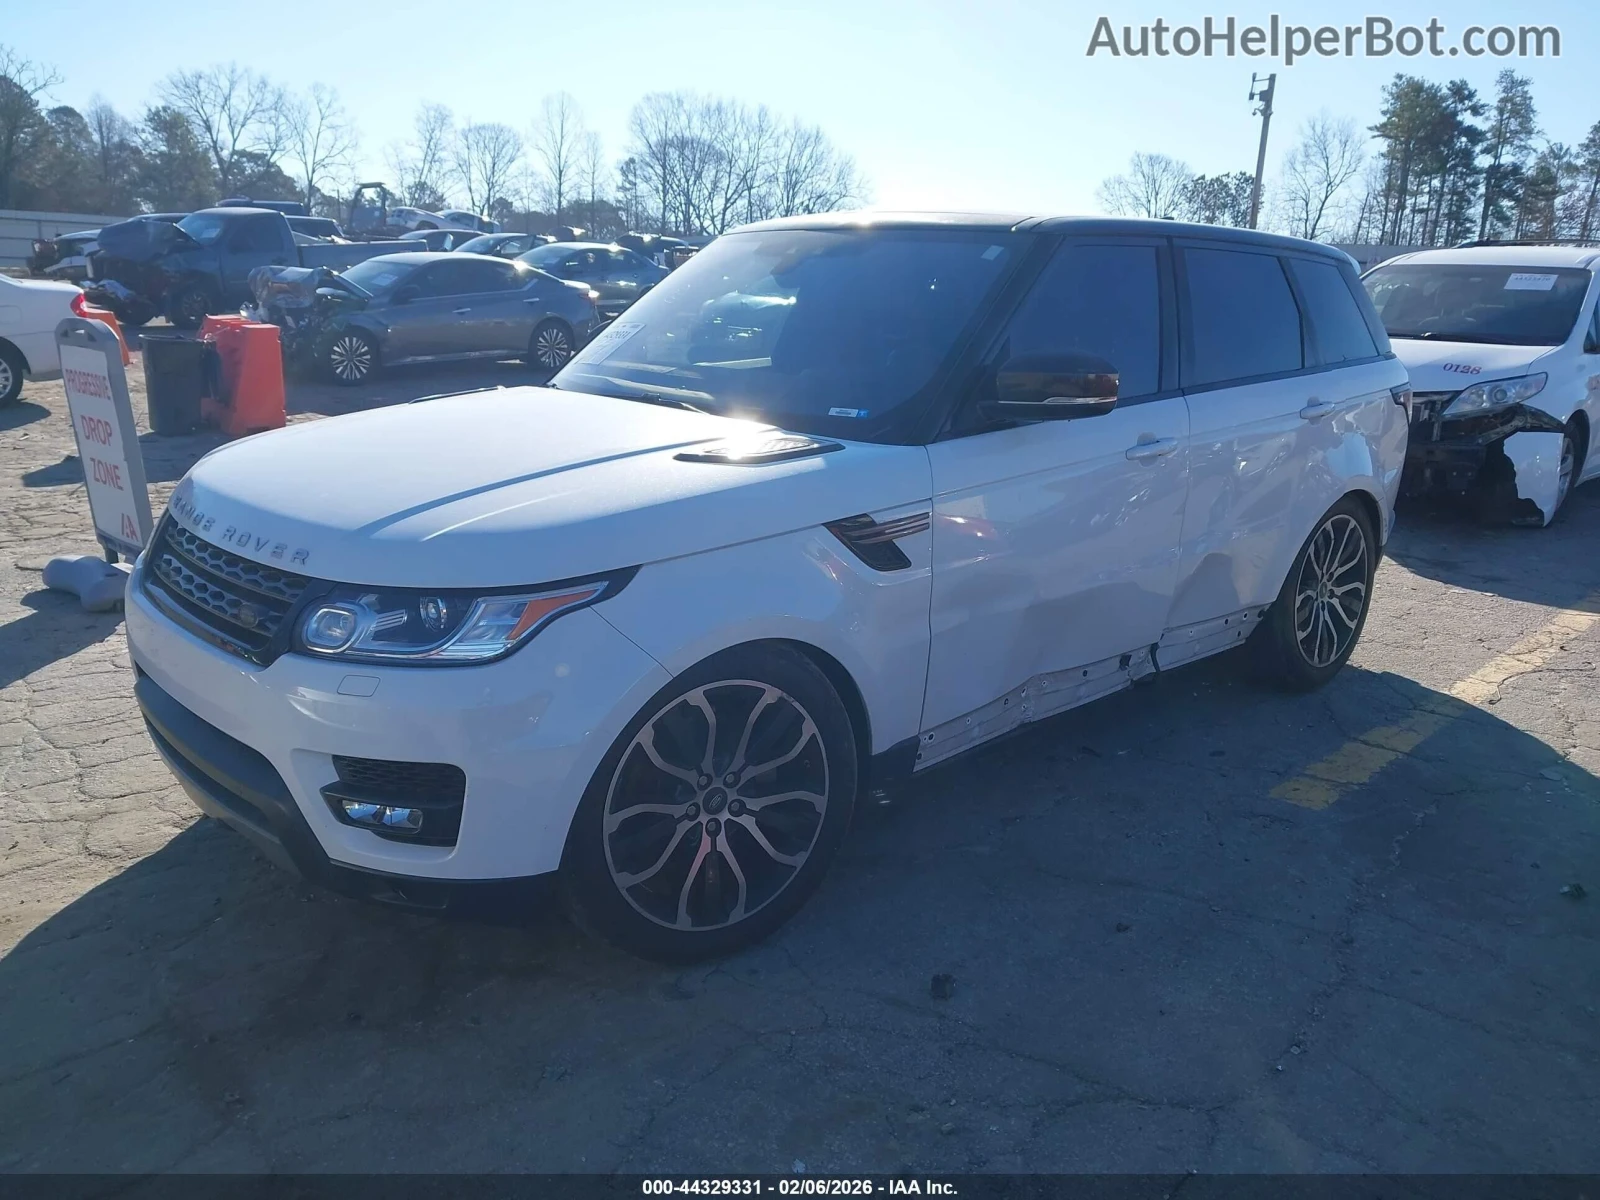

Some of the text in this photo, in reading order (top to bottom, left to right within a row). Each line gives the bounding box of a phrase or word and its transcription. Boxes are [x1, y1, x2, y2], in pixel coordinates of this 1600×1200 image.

[80, 414, 113, 447] DROP
[90, 457, 124, 492] ZONE
[221, 525, 310, 566] ROVER
